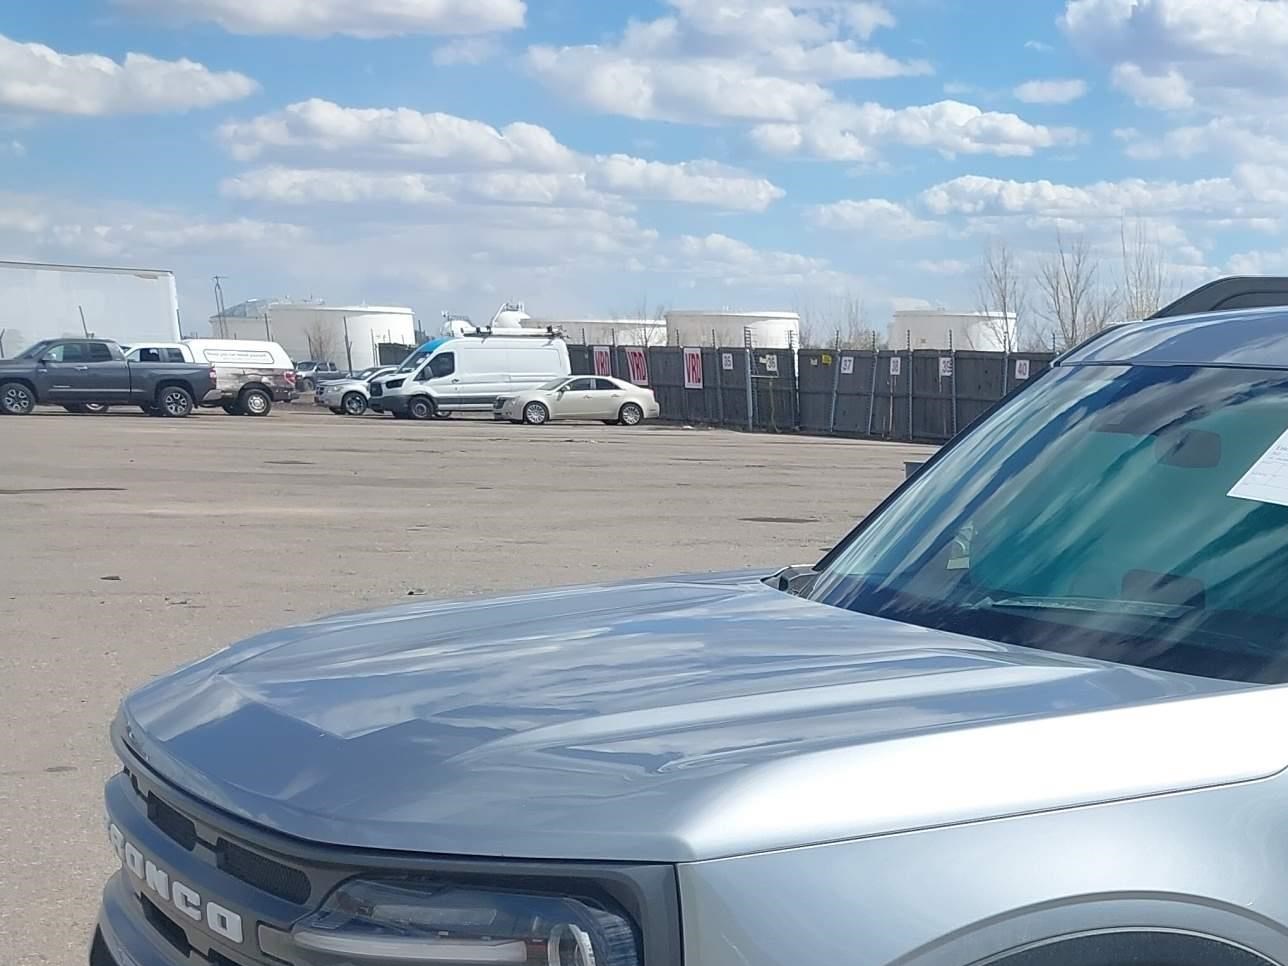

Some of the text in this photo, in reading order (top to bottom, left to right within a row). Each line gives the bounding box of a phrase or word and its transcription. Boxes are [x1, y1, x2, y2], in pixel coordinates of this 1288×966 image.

[627, 351, 647, 381] VRD
[685, 352, 701, 384] VRD
[1018, 361, 1027, 376] 40
